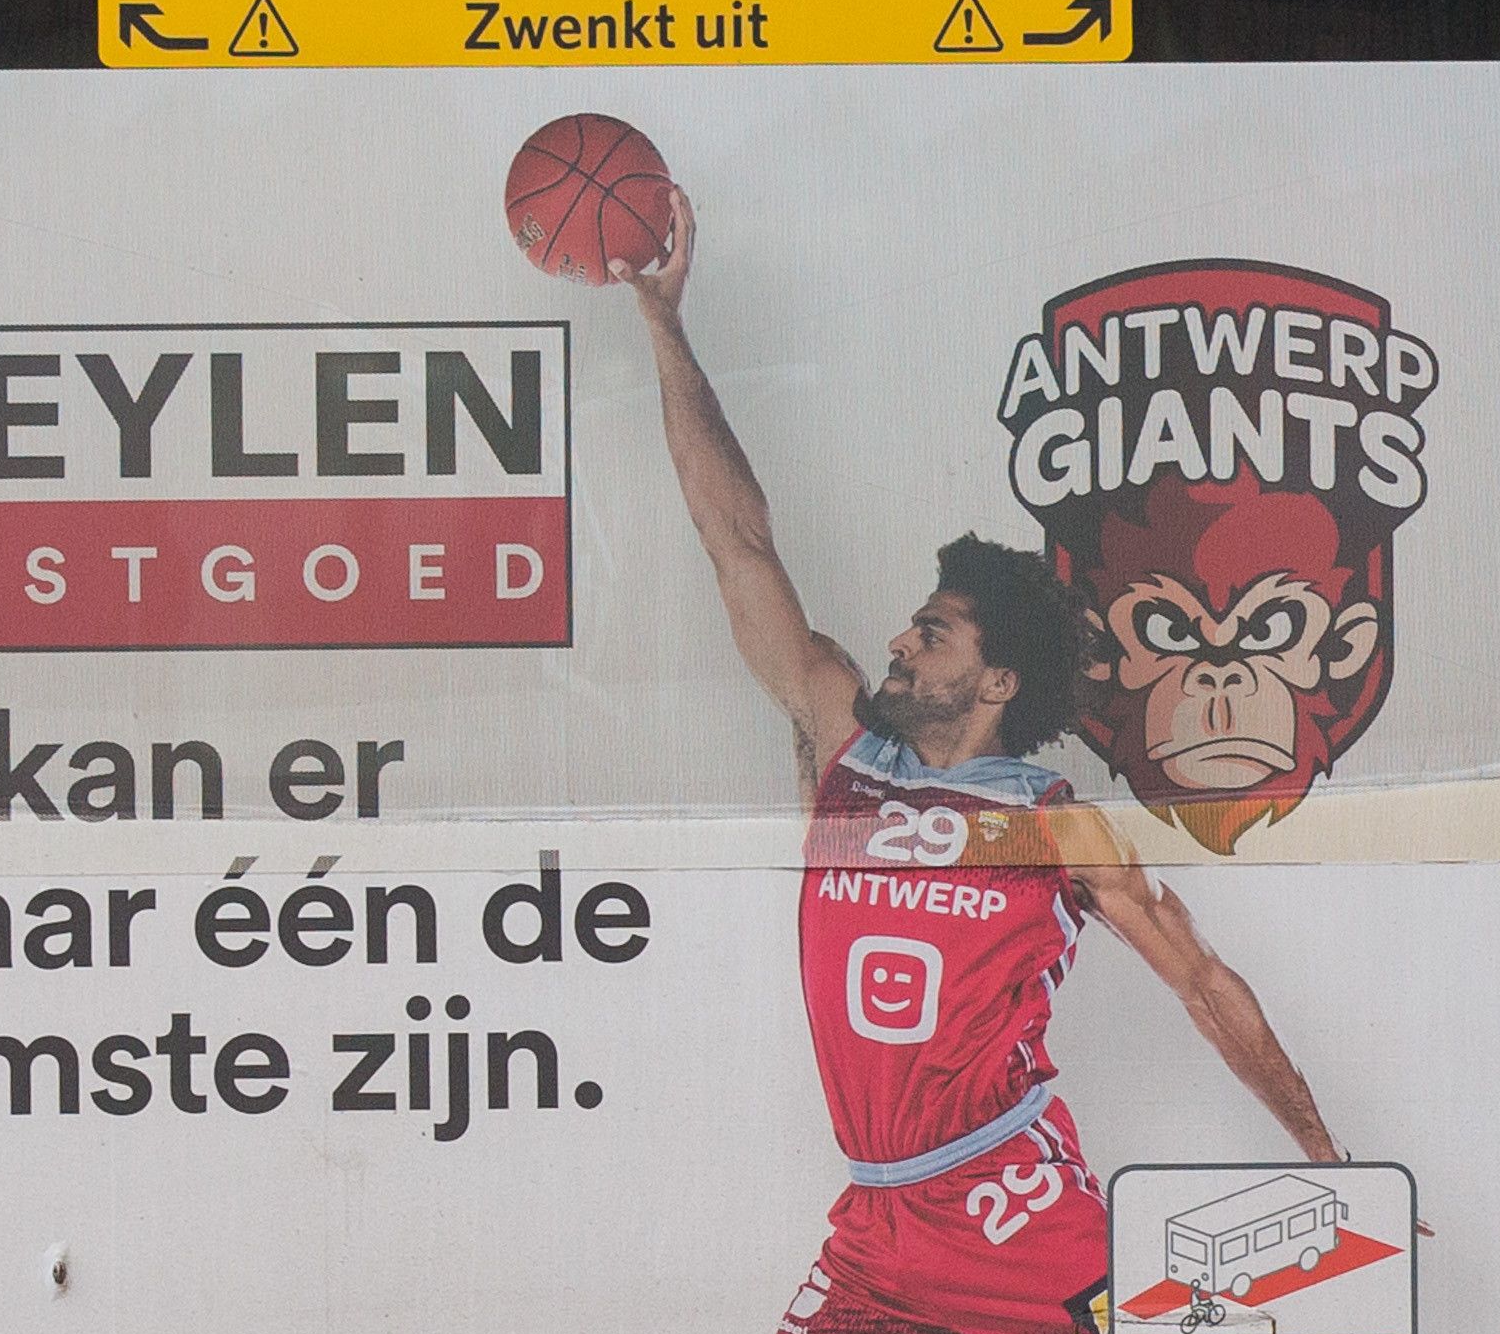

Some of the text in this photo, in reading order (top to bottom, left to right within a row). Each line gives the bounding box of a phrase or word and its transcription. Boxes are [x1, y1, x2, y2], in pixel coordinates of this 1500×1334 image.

[464, 0, 770, 53] Zwenkt uit
[1001, 305, 1438, 419] ANTWERP
[1011, 387, 1428, 508] GIANTS
[269, 733, 407, 821] er
[864, 799, 970, 868] 29
[194, 853, 439, 970] één
[482, 849, 651, 967] de
[817, 868, 1009, 921] ANTWERP
[332, 995, 605, 1142] zijn.
[964, 1164, 1066, 1246] 29
